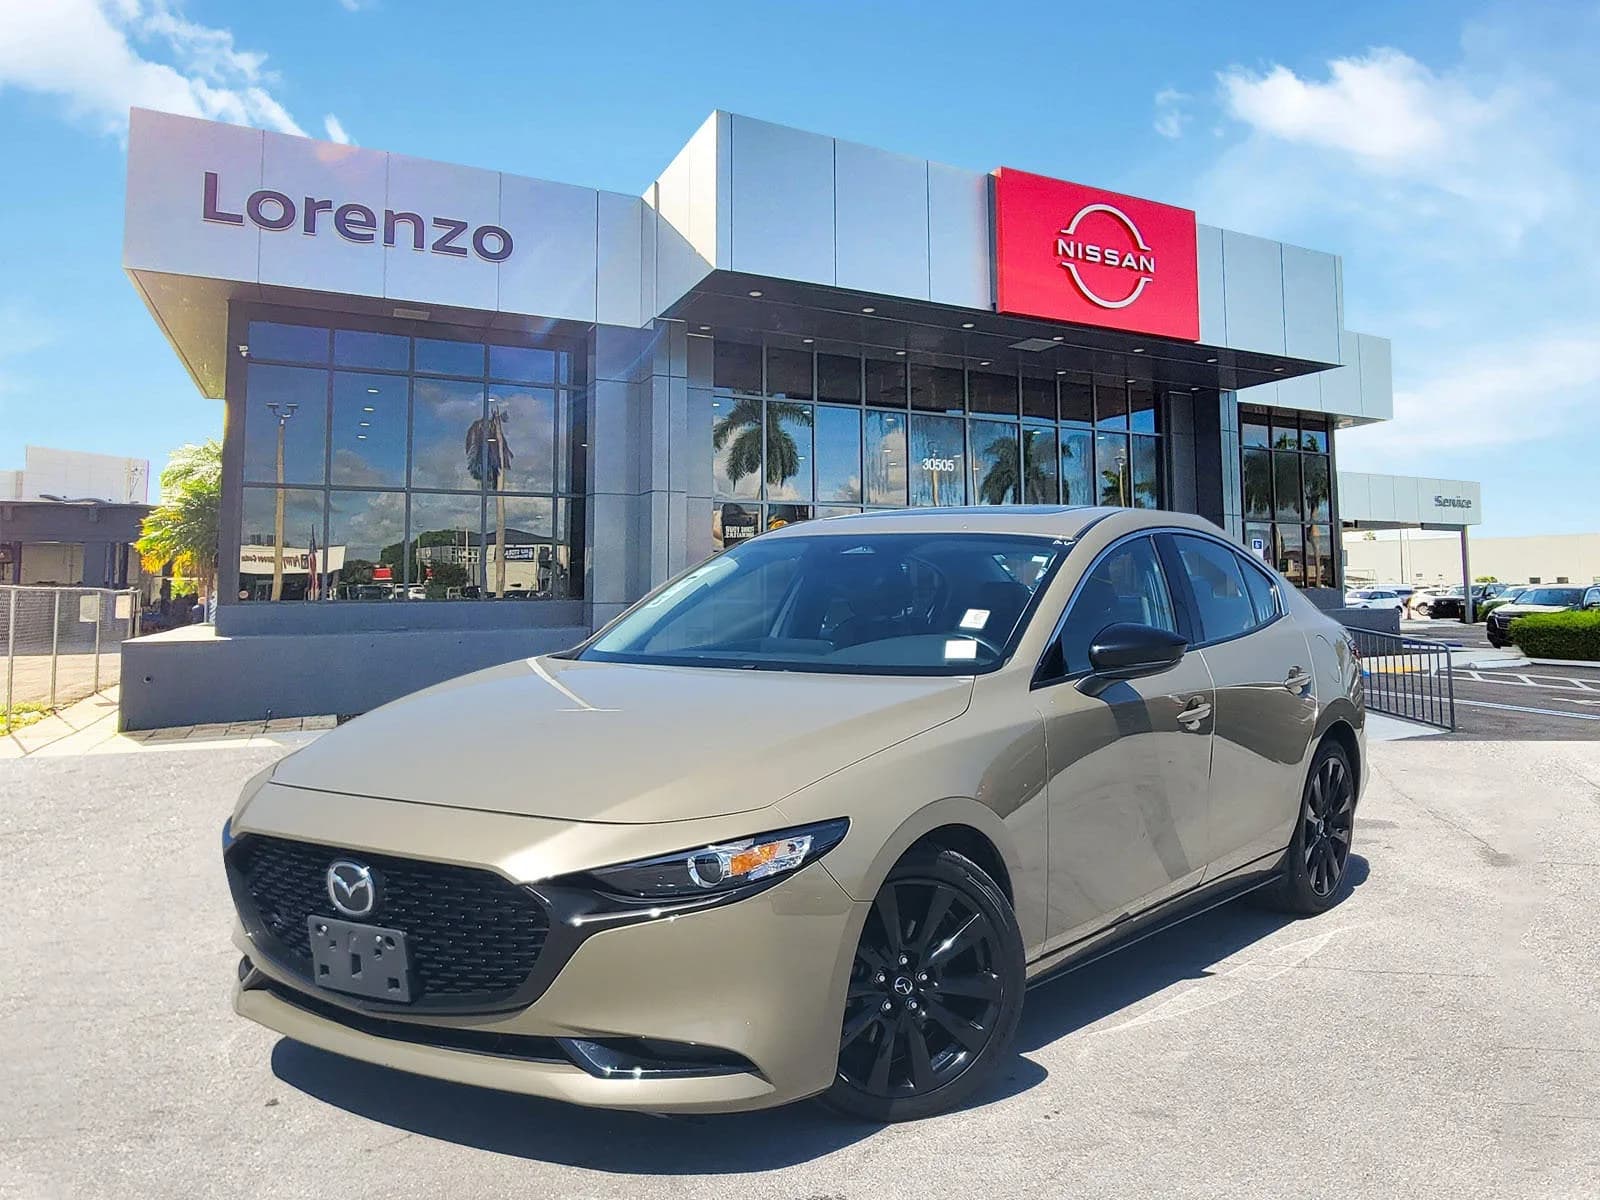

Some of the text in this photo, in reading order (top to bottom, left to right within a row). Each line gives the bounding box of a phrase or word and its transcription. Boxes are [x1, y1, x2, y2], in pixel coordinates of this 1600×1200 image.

[202, 171, 514, 262] Lorenzo
[1057, 238, 1155, 273] NISSAN
[922, 457, 955, 472] 30505
[1434, 495, 1472, 509] Service
